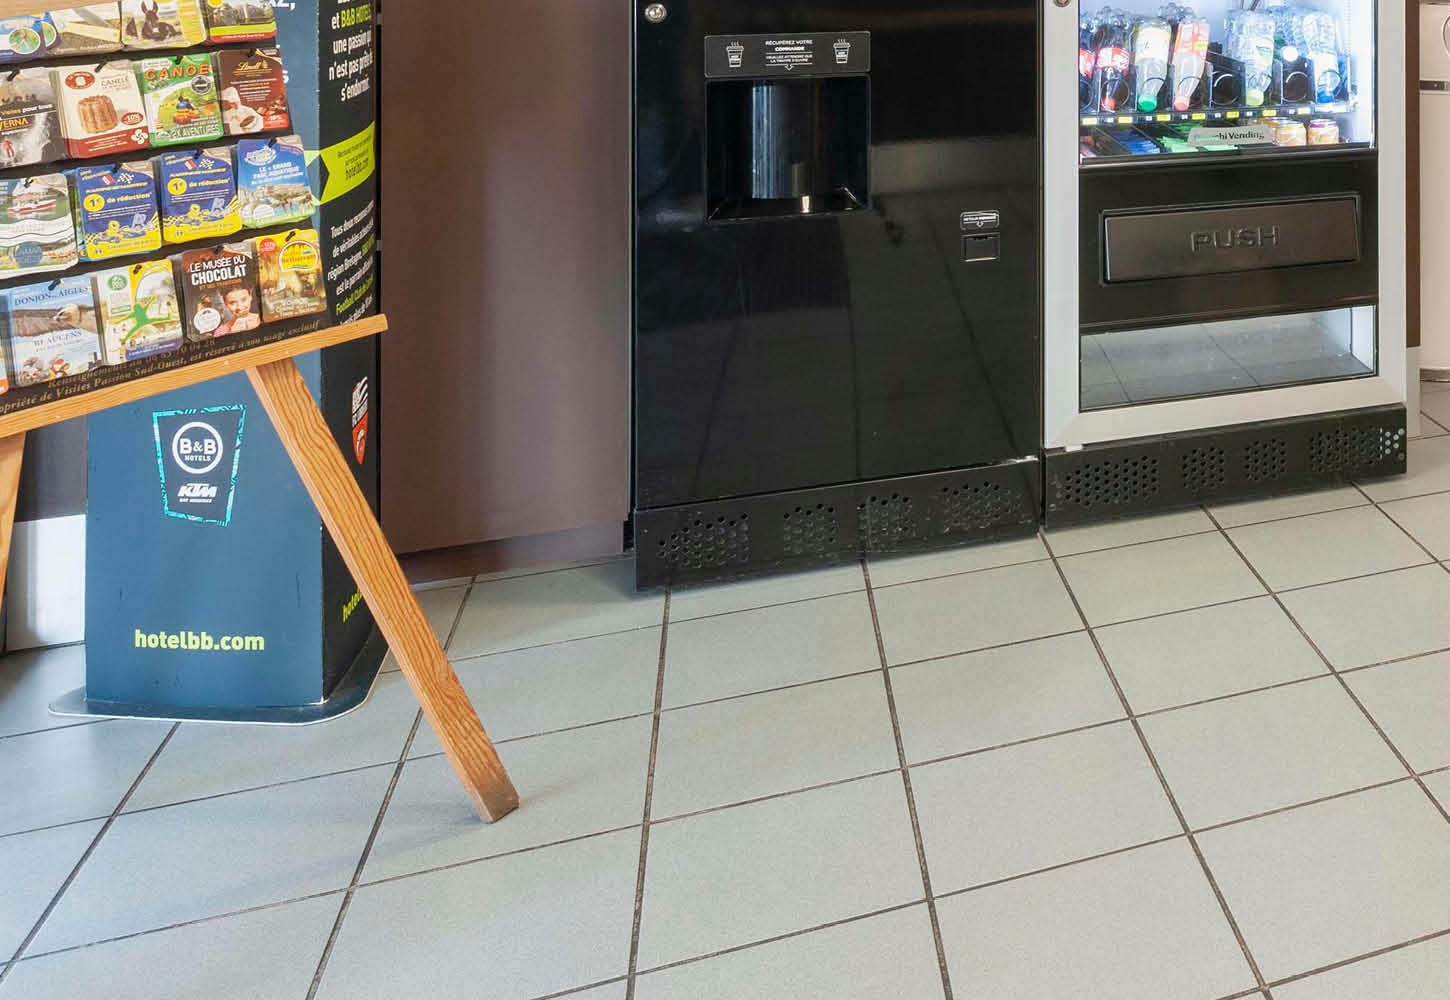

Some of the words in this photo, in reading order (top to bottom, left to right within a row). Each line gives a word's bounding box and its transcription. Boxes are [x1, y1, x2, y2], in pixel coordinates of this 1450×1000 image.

[331, 11, 340, 30] et
[333, 38, 347, 54] une
[144, 64, 210, 81] CANOE
[329, 60, 348, 81] n'est
[349, 58, 359, 78] pas
[1190, 224, 1280, 253] PUSH
[190, 262, 200, 273] LE
[202, 256, 233, 270] MUSÉE
[233, 255, 246, 267] DU
[191, 264, 247, 286] CHOCOLAT
[14, 294, 51, 306] DONJON
[56, 381, 91, 396] Visites
[93, 371, 132, 387] Passion
[180, 437, 216, 455] B&B
[135, 630, 265, 651] hotelbb.com
